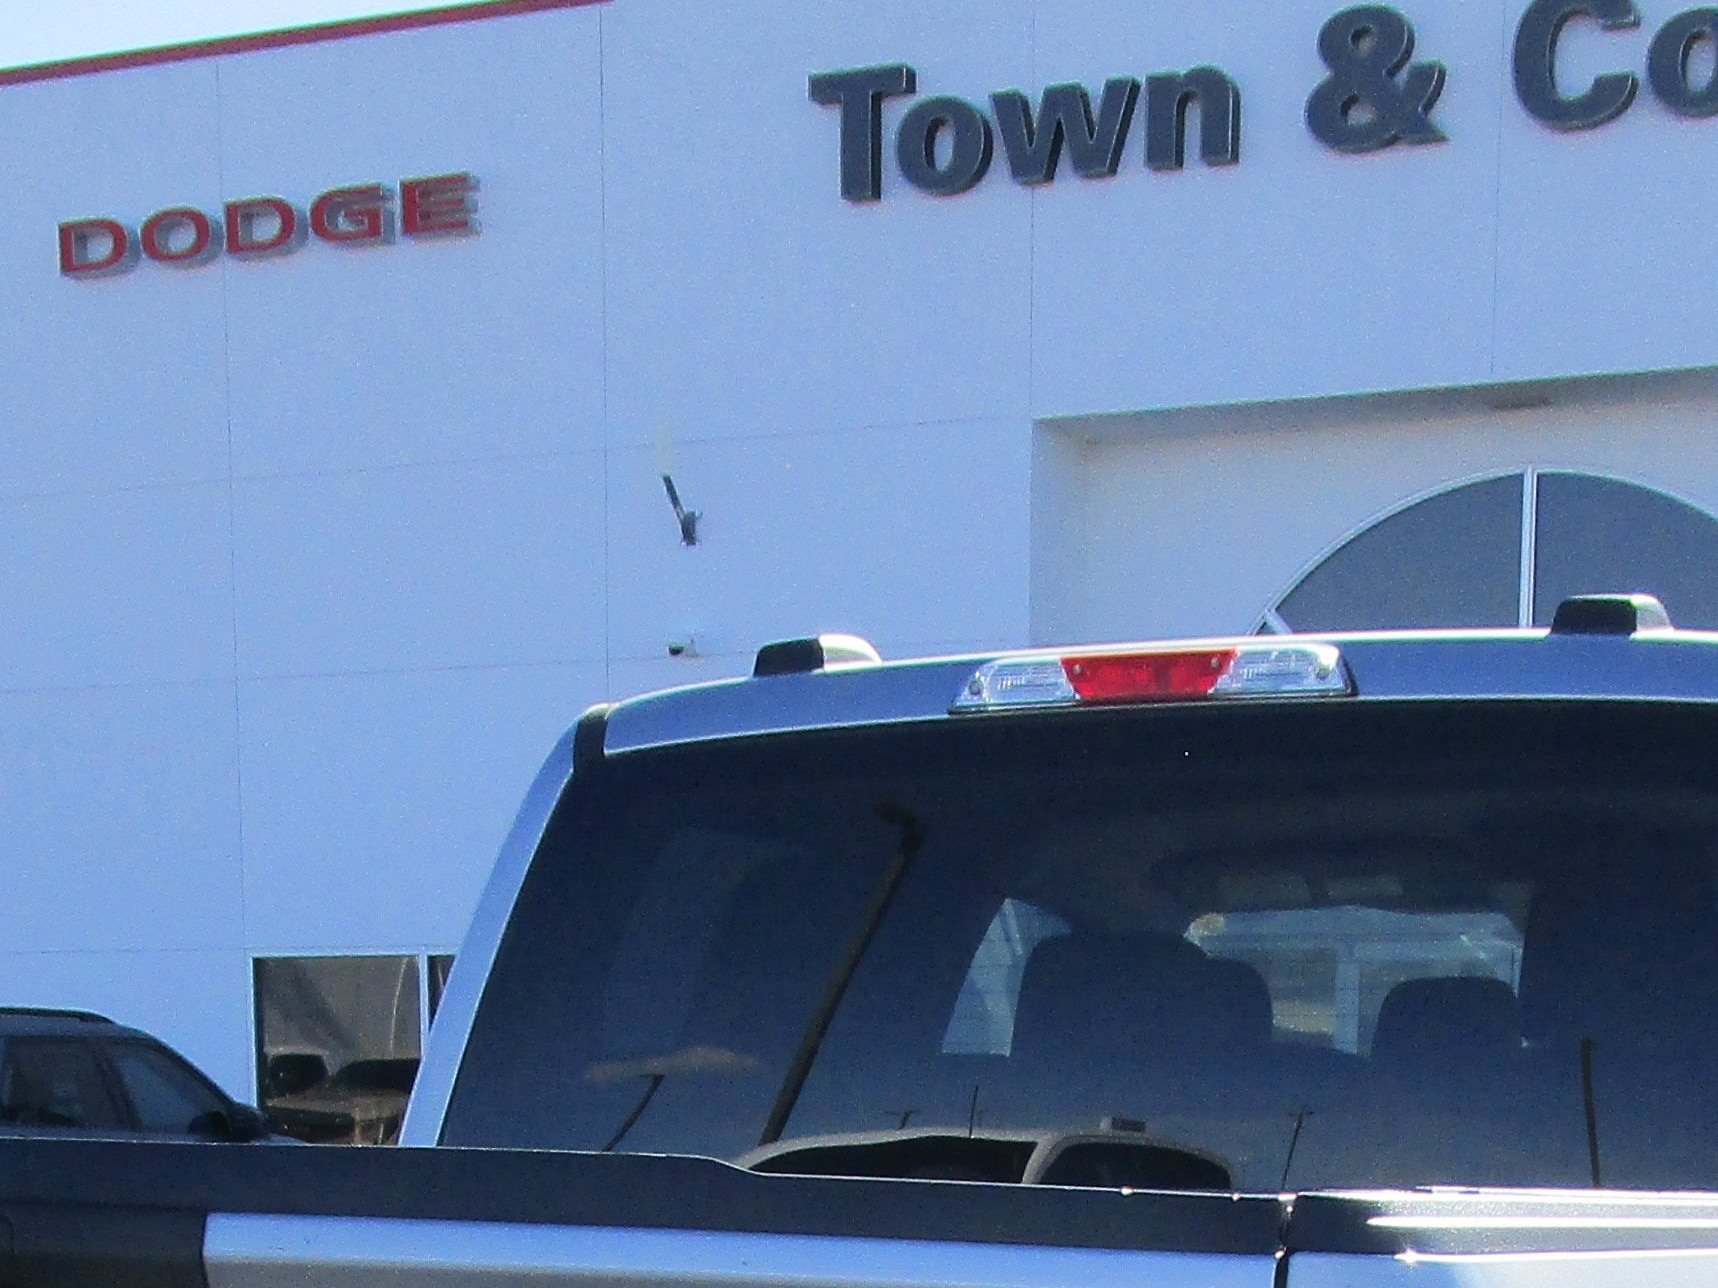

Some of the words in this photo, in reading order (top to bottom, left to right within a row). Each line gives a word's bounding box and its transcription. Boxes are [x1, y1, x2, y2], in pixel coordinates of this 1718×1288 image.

[807, 62, 1241, 203] Town
[1303, 3, 1448, 153] &
[57, 171, 483, 281] DODGE
